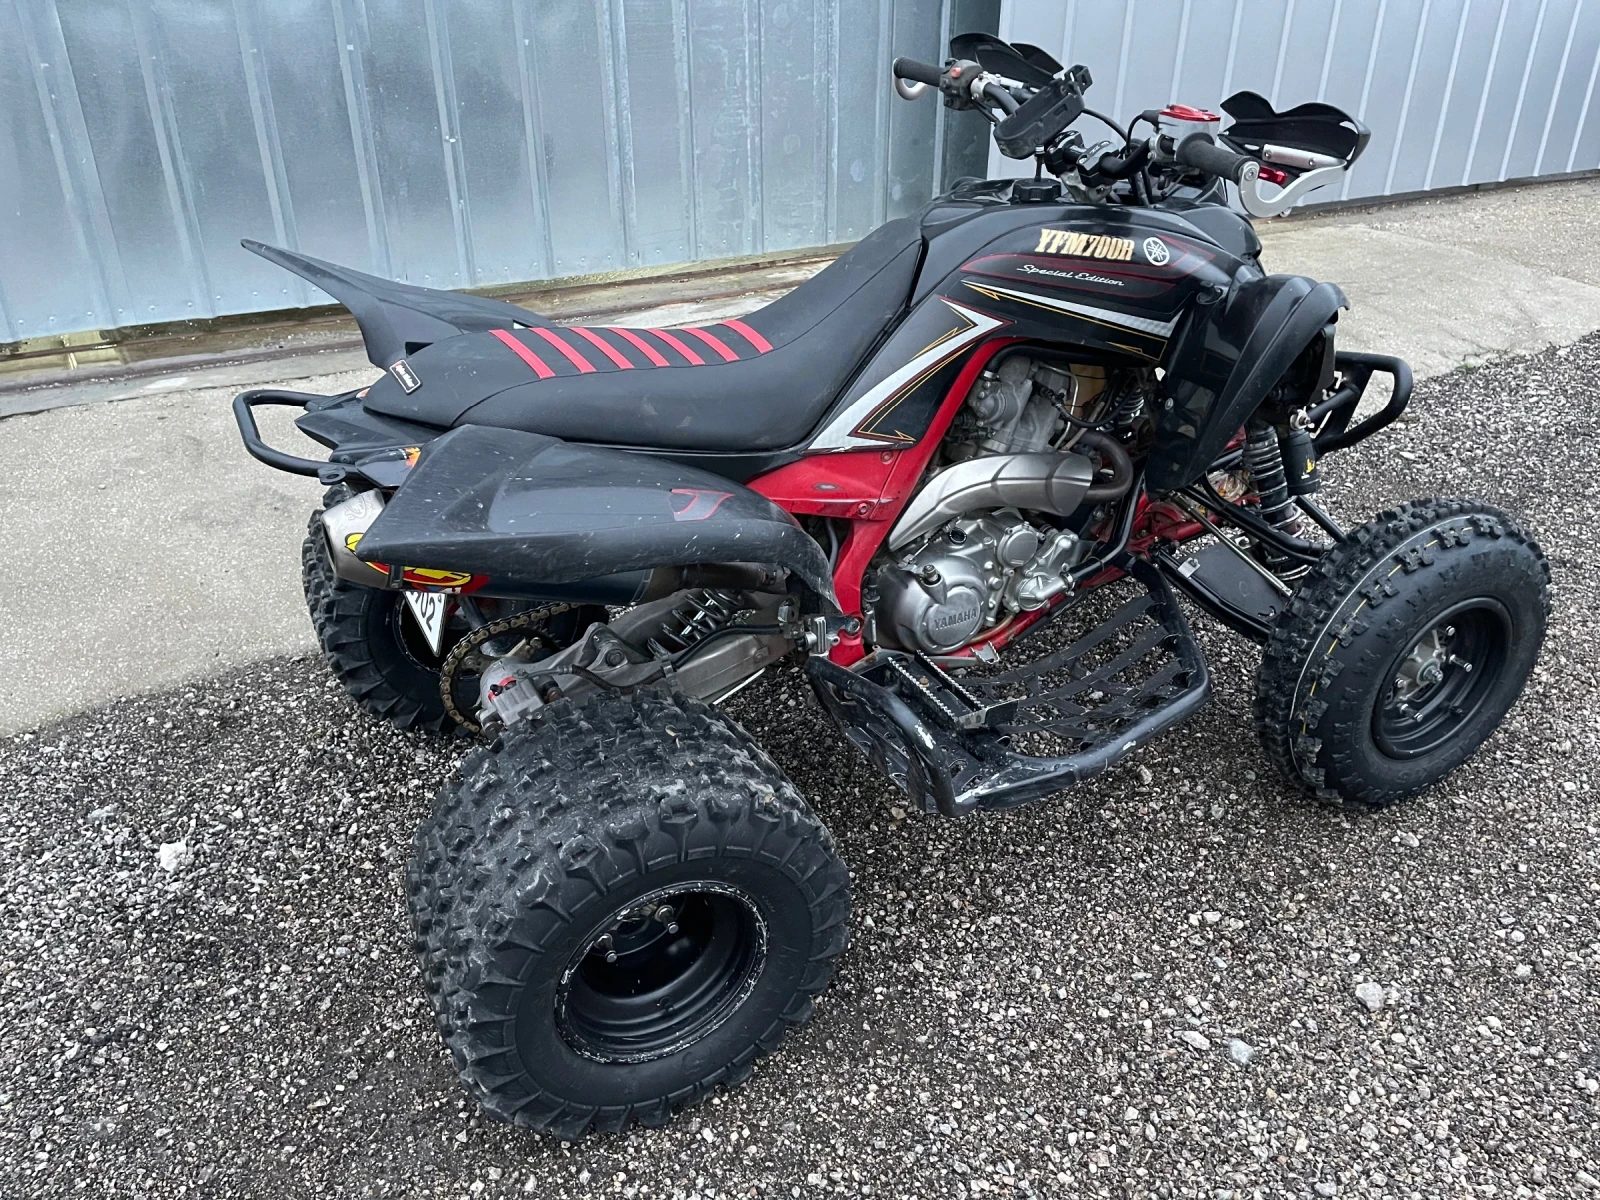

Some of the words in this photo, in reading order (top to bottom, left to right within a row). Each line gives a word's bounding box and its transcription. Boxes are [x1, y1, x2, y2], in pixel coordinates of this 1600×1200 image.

[1035, 229, 1135, 260] YFM700R
[1017, 264, 1073, 279] Special
[1075, 272, 1124, 286] Edition
[934, 609, 977, 630] YAMAHA
